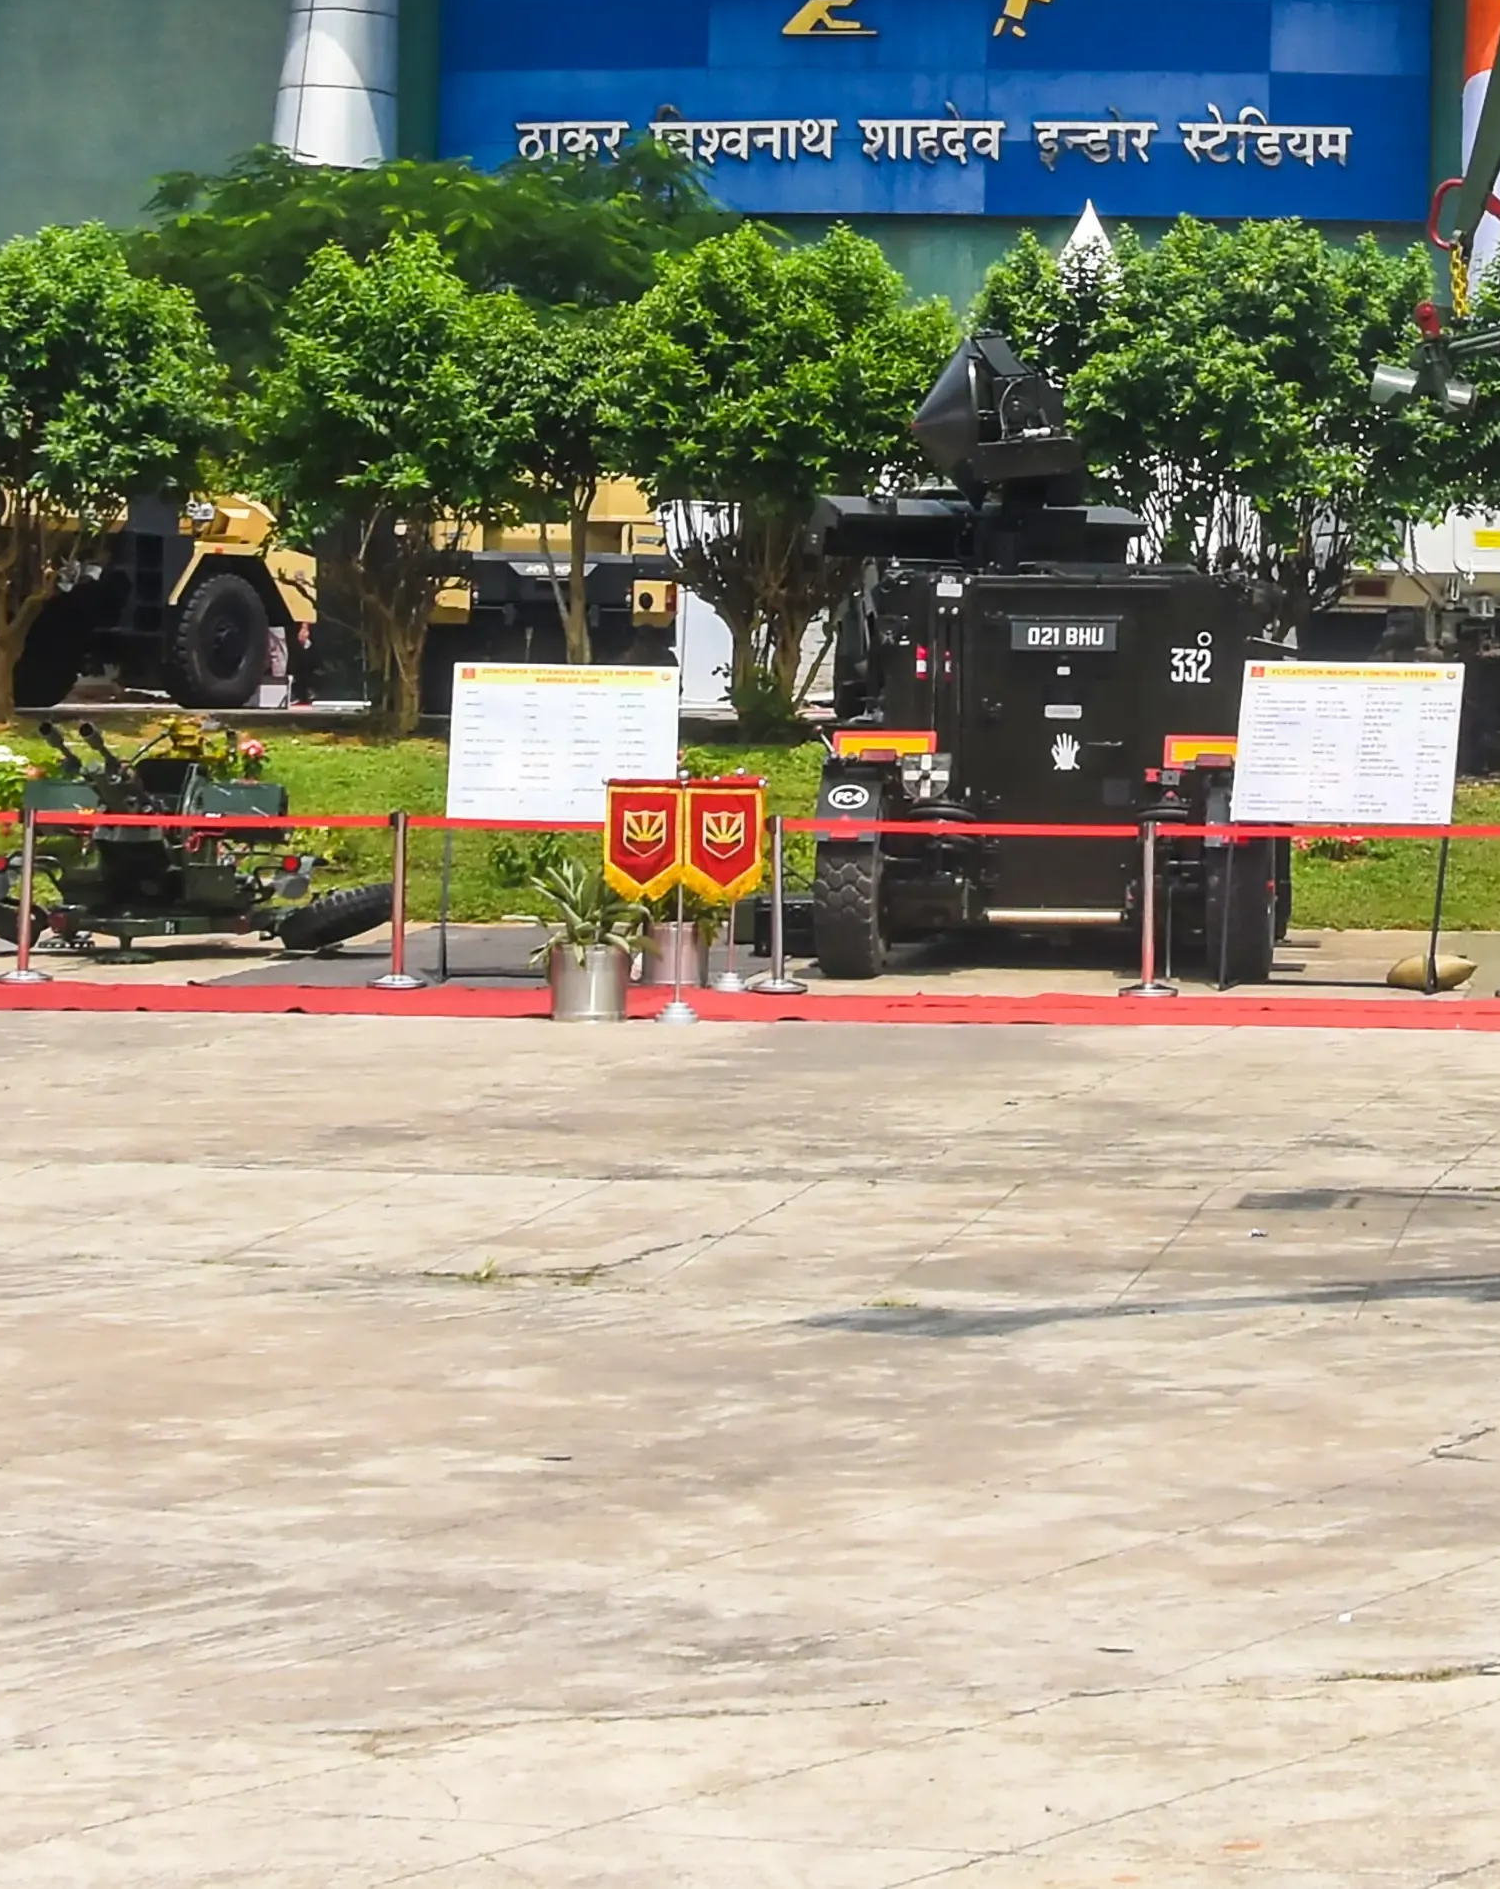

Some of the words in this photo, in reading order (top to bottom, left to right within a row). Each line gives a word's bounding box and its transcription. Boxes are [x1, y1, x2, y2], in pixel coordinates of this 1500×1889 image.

[858, 101, 1005, 165] शाहदेव
[1178, 102, 1354, 167] स्टेडियम
[1028, 627, 1059, 645] 021
[1065, 627, 1105, 645] BHU
[1170, 647, 1213, 683] 332
